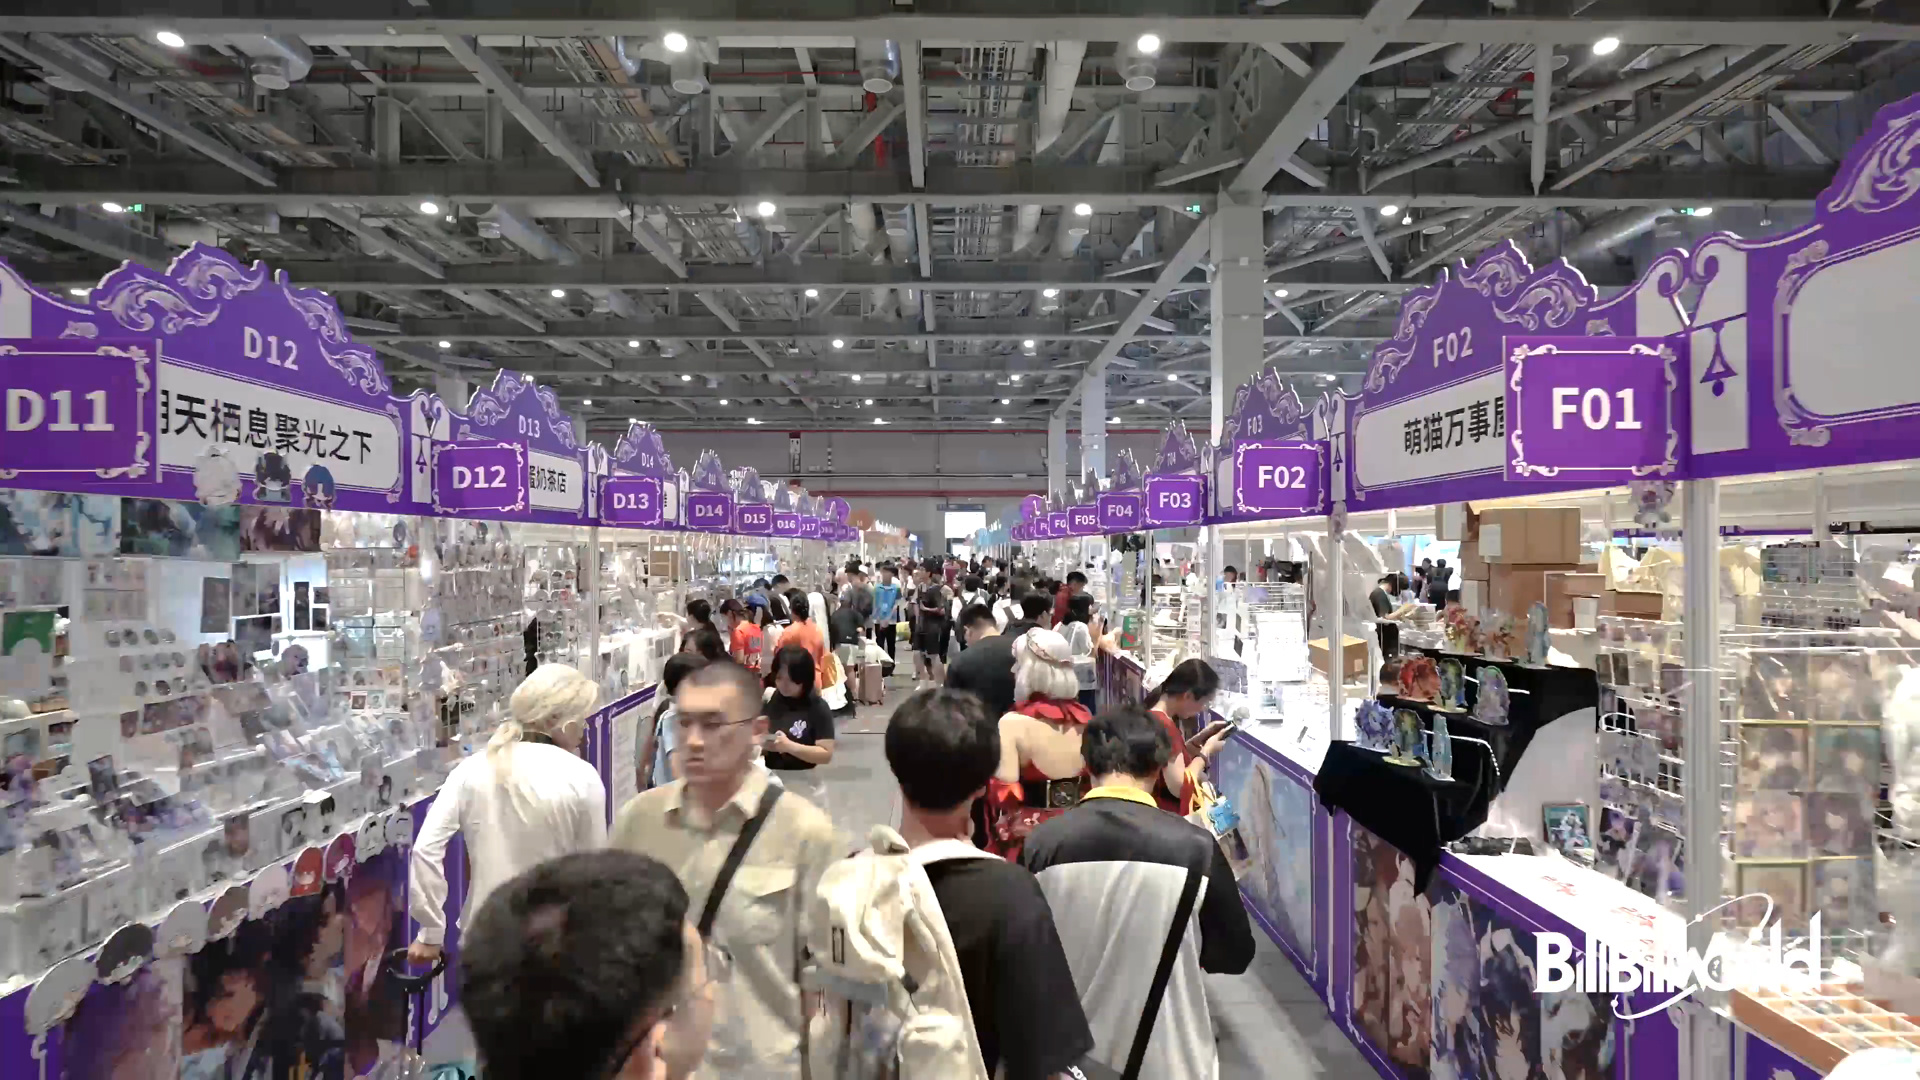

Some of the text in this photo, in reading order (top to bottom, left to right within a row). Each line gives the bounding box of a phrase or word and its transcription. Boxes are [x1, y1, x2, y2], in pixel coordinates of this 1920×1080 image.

[244, 326, 299, 371] D12
[1433, 326, 1473, 368] F02
[6, 388, 115, 432] D11
[1552, 387, 1642, 430] F01
[161, 389, 372, 464] 天栖息聚光之下
[519, 415, 540, 438] D13
[1247, 414, 1263, 436] F03
[641, 452, 654, 468] D14
[452, 465, 507, 489] D12
[1258, 465, 1306, 489] F02
[613, 492, 649, 509] D13
[695, 504, 724, 518] D14
[1107, 505, 1133, 517] F04
[1159, 492, 1192, 508] F03
[744, 513, 766, 524] D15
[777, 520, 796, 529] D16
[1075, 515, 1095, 525] F05
